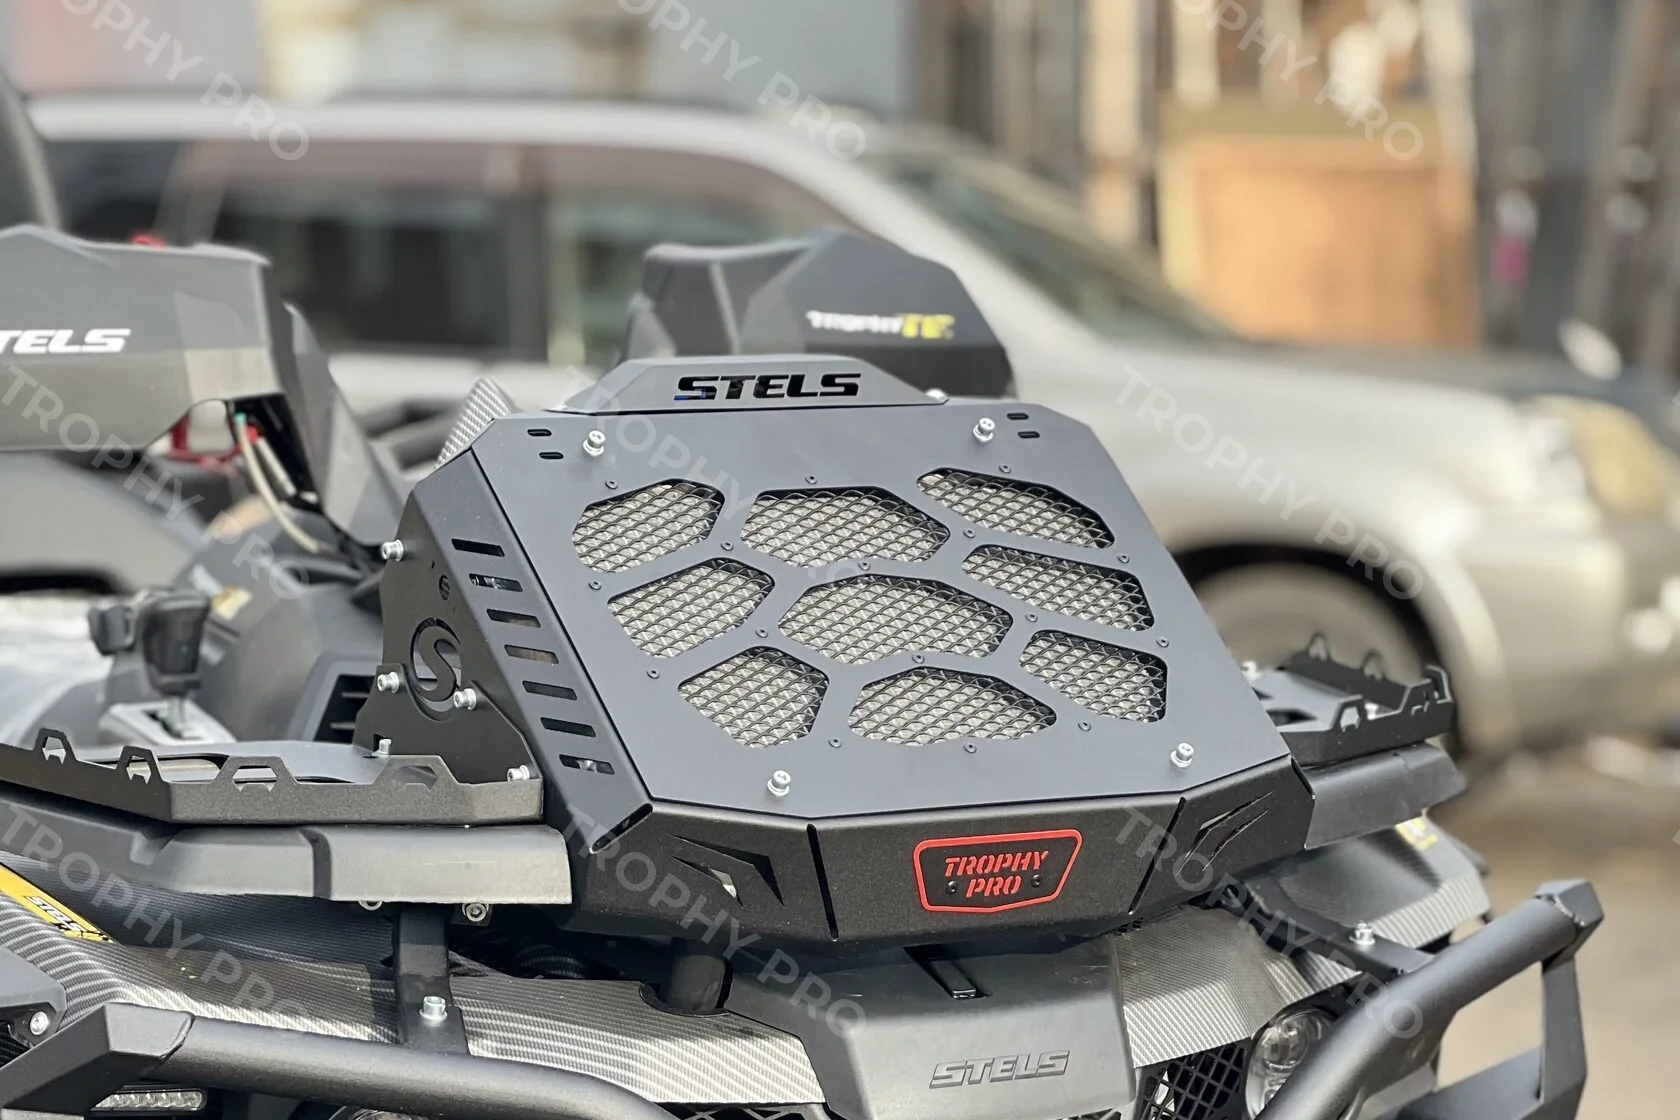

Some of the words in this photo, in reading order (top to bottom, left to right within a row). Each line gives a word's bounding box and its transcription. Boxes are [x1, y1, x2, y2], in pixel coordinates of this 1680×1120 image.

[674, 373, 861, 400] STELS
[945, 851, 1048, 877] TROPHY
[966, 875, 1022, 898] PRO
[929, 1050, 1070, 1089] STELS
